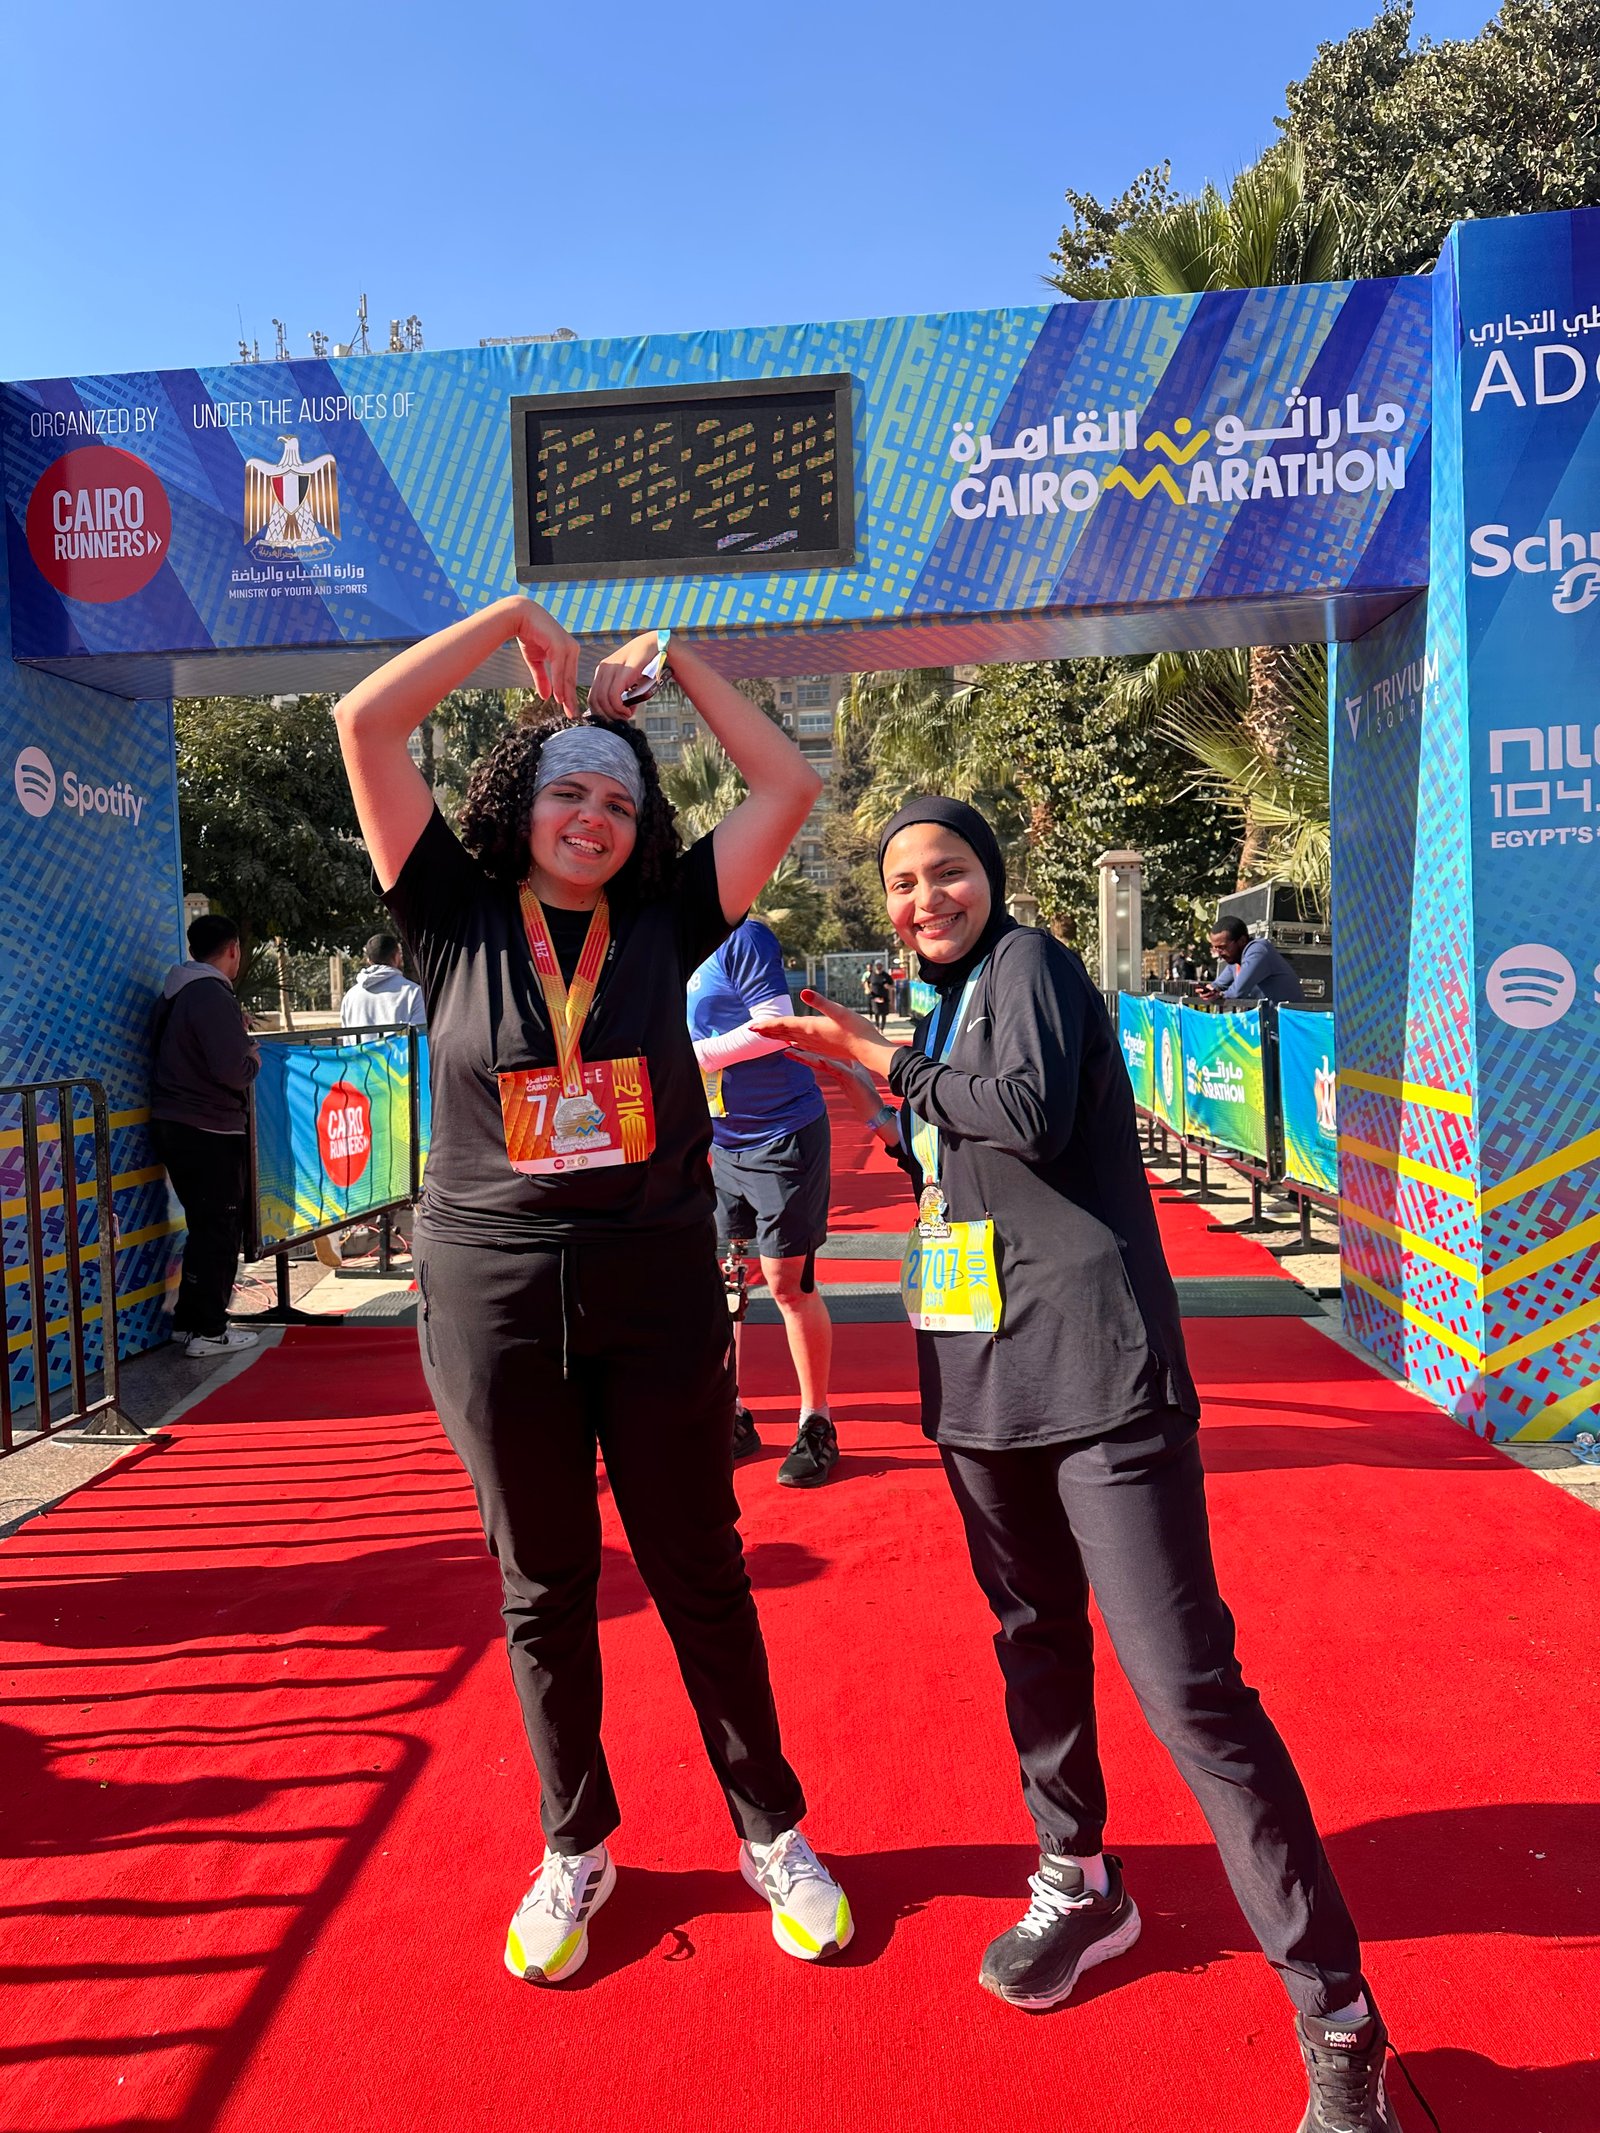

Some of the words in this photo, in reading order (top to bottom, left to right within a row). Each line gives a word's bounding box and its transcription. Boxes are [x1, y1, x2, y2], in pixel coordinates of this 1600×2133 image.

[1469, 309, 1556, 347] التجاري
[30, 409, 131, 438] ORGANIZED
[135, 406, 159, 432] BY
[193, 401, 253, 429] UNDER
[258, 399, 292, 426] THE
[299, 394, 389, 424] AUSPICES
[391, 392, 415, 418] OF
[948, 409, 1138, 474] القاهرة
[53, 486, 145, 533] CAIRO
[950, 469, 1099, 520] CAIRO
[54, 530, 145, 560] RUNNERS
[231, 565, 283, 583] والرياضة
[286, 563, 331, 581] الشباب
[334, 563, 365, 579] وزارة
[229, 588, 269, 599] MINISTRY
[271, 588, 282, 597] OF
[284, 586, 312, 596] YOUTH
[314, 585, 332, 595] AND
[334, 584, 368, 595] SPORTS
[1373, 648, 1439, 714] TRIVIUM
[1377, 685, 1439, 734] SQUARE
[1490, 723, 1600, 774] NIL
[63, 771, 143, 826] Spotify
[526, 1083, 548, 1092] CAIRO
[614, 1083, 646, 1124] 21K
[907, 1249, 958, 1289] 2707
[967, 1250, 989, 1287] 10K
[1042, 1865, 1063, 1882] HOKA
[1324, 2031, 1357, 2042] HOKA
